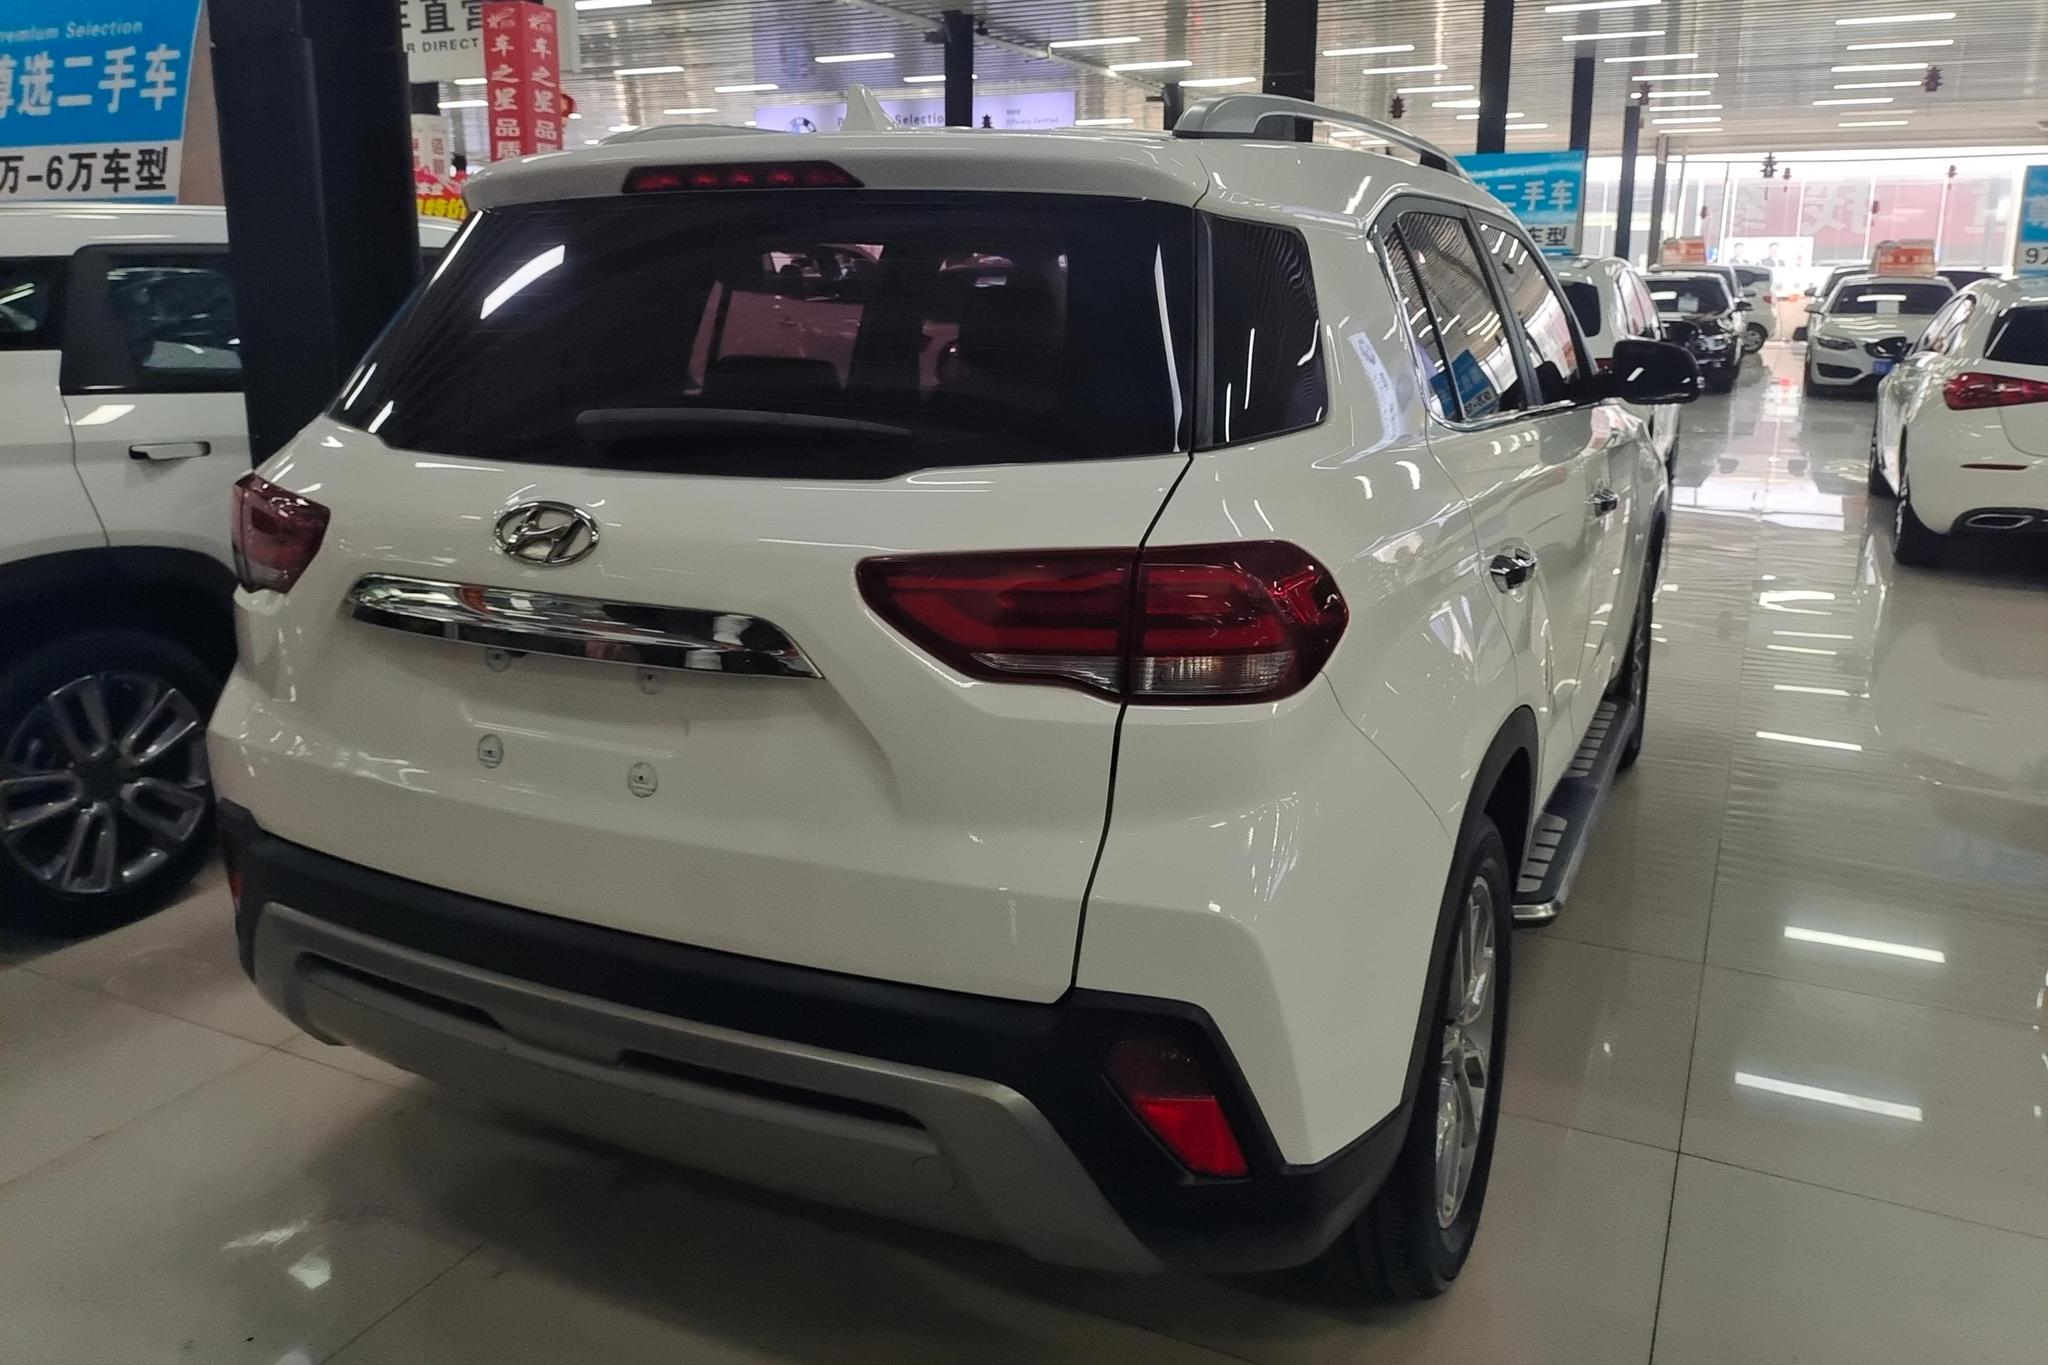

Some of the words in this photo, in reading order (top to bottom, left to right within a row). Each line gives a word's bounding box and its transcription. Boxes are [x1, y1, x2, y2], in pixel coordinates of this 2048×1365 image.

[0, 27, 59, 43] remium
[65, 20, 143, 39] Selection
[422, 38, 479, 52] DIRECT
[1480, 179, 1574, 212] 二手车
